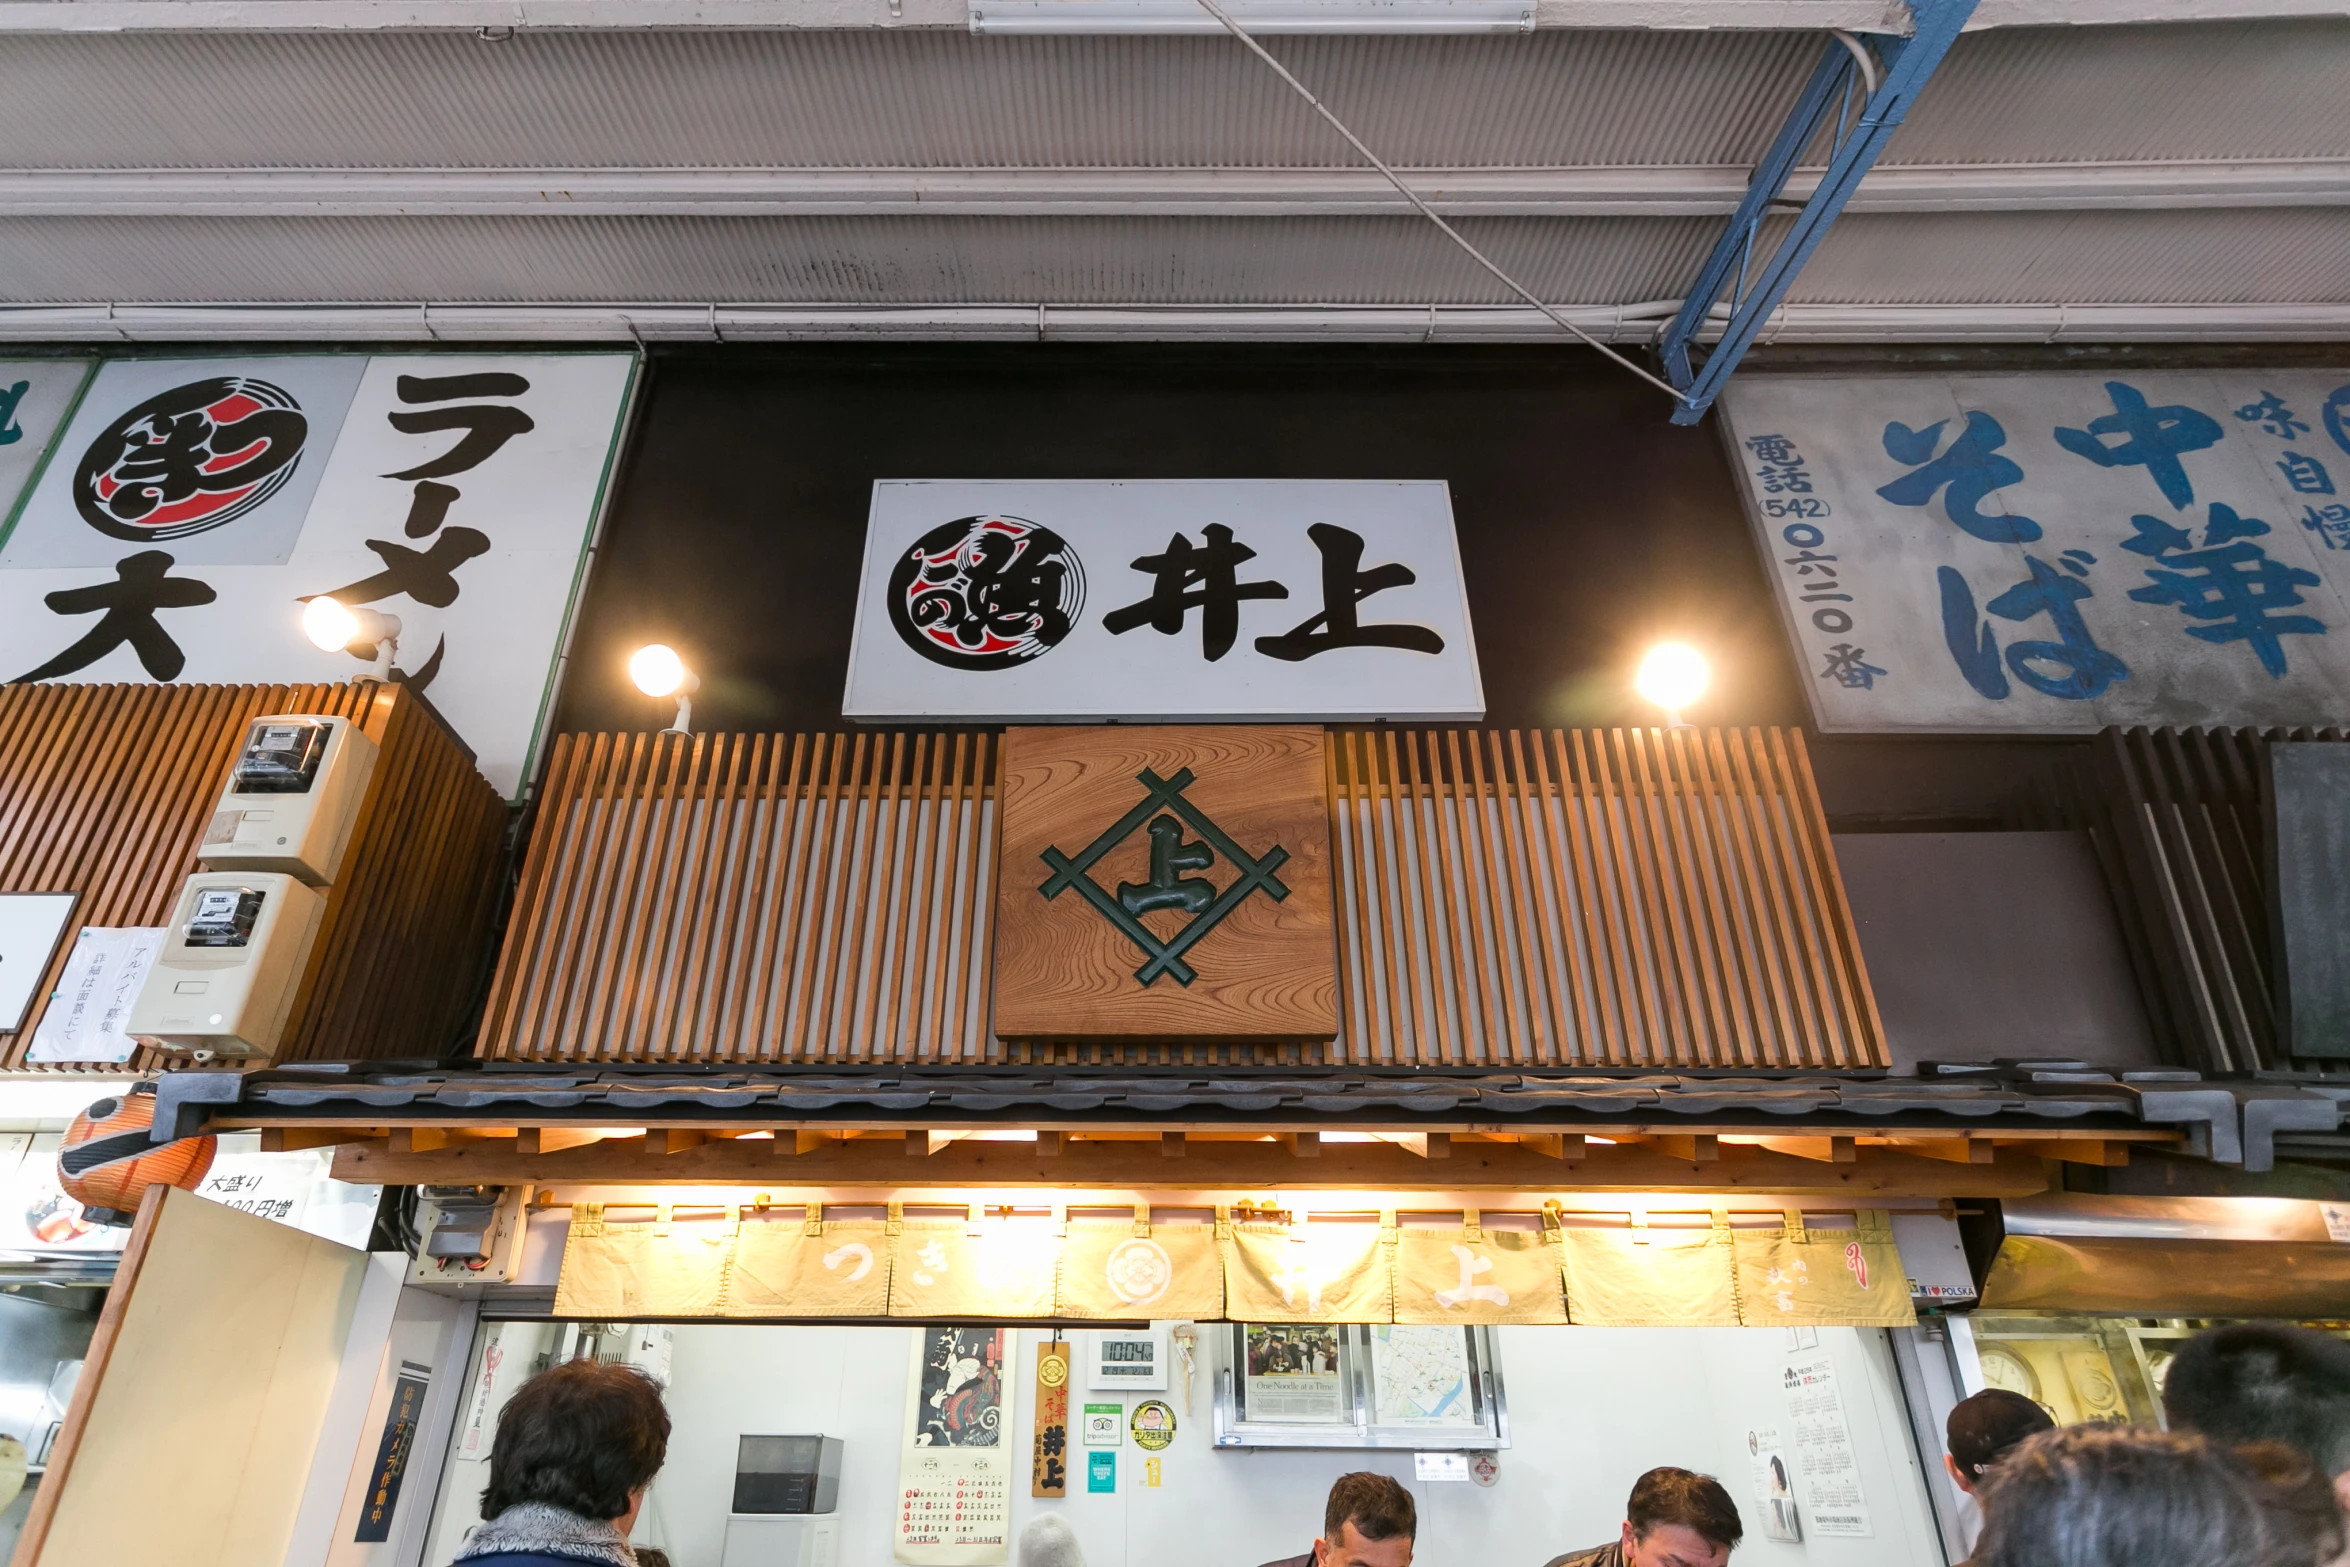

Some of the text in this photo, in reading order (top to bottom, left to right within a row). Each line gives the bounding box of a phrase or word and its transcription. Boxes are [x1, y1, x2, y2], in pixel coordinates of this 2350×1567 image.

[296, 373, 535, 693] ラーメ
[1876, 411, 2130, 700] そば
[2054, 381, 2328, 679] 中華
[8, 550, 217, 683] 大
[1103, 523, 1444, 662] 井上
[1116, 814, 1217, 918] 上
[64, 952, 107, 1041] 詳細は面談にて
[100, 947, 147, 1034] アルバイト募集
[206, 1174, 263, 1192] 大盛り
[1927, 1287, 1975, 1296] I POLSKA
[1109, 1343, 1145, 1361] 10:04
[1256, 1381, 1272, 1390] One
[1273, 1382, 1299, 1390] Noodle
[1314, 1382, 1334, 1391] Time
[1044, 1398, 1055, 1424] そば
[1055, 1386, 1067, 1420] 中華
[371, 1386, 414, 1524] 防犯カメラ作動中
[1041, 1425, 1065, 1489] 井上
